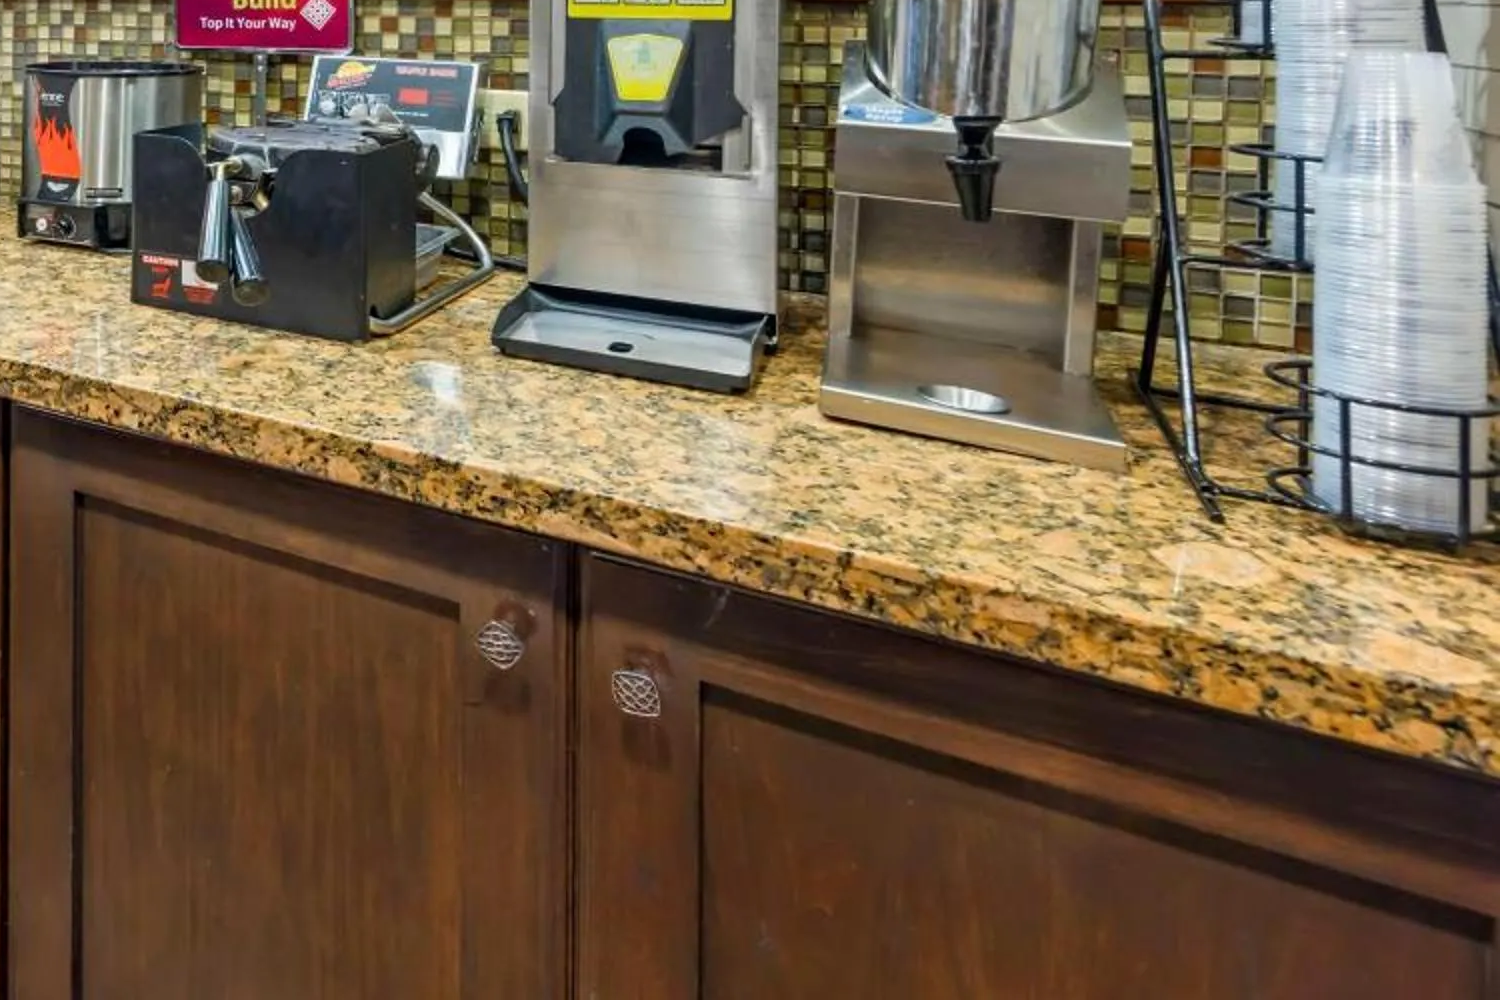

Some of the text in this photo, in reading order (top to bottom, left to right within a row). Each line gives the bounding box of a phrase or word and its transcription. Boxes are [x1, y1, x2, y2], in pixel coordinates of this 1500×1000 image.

[199, 17, 297, 32] Top It Your Way
